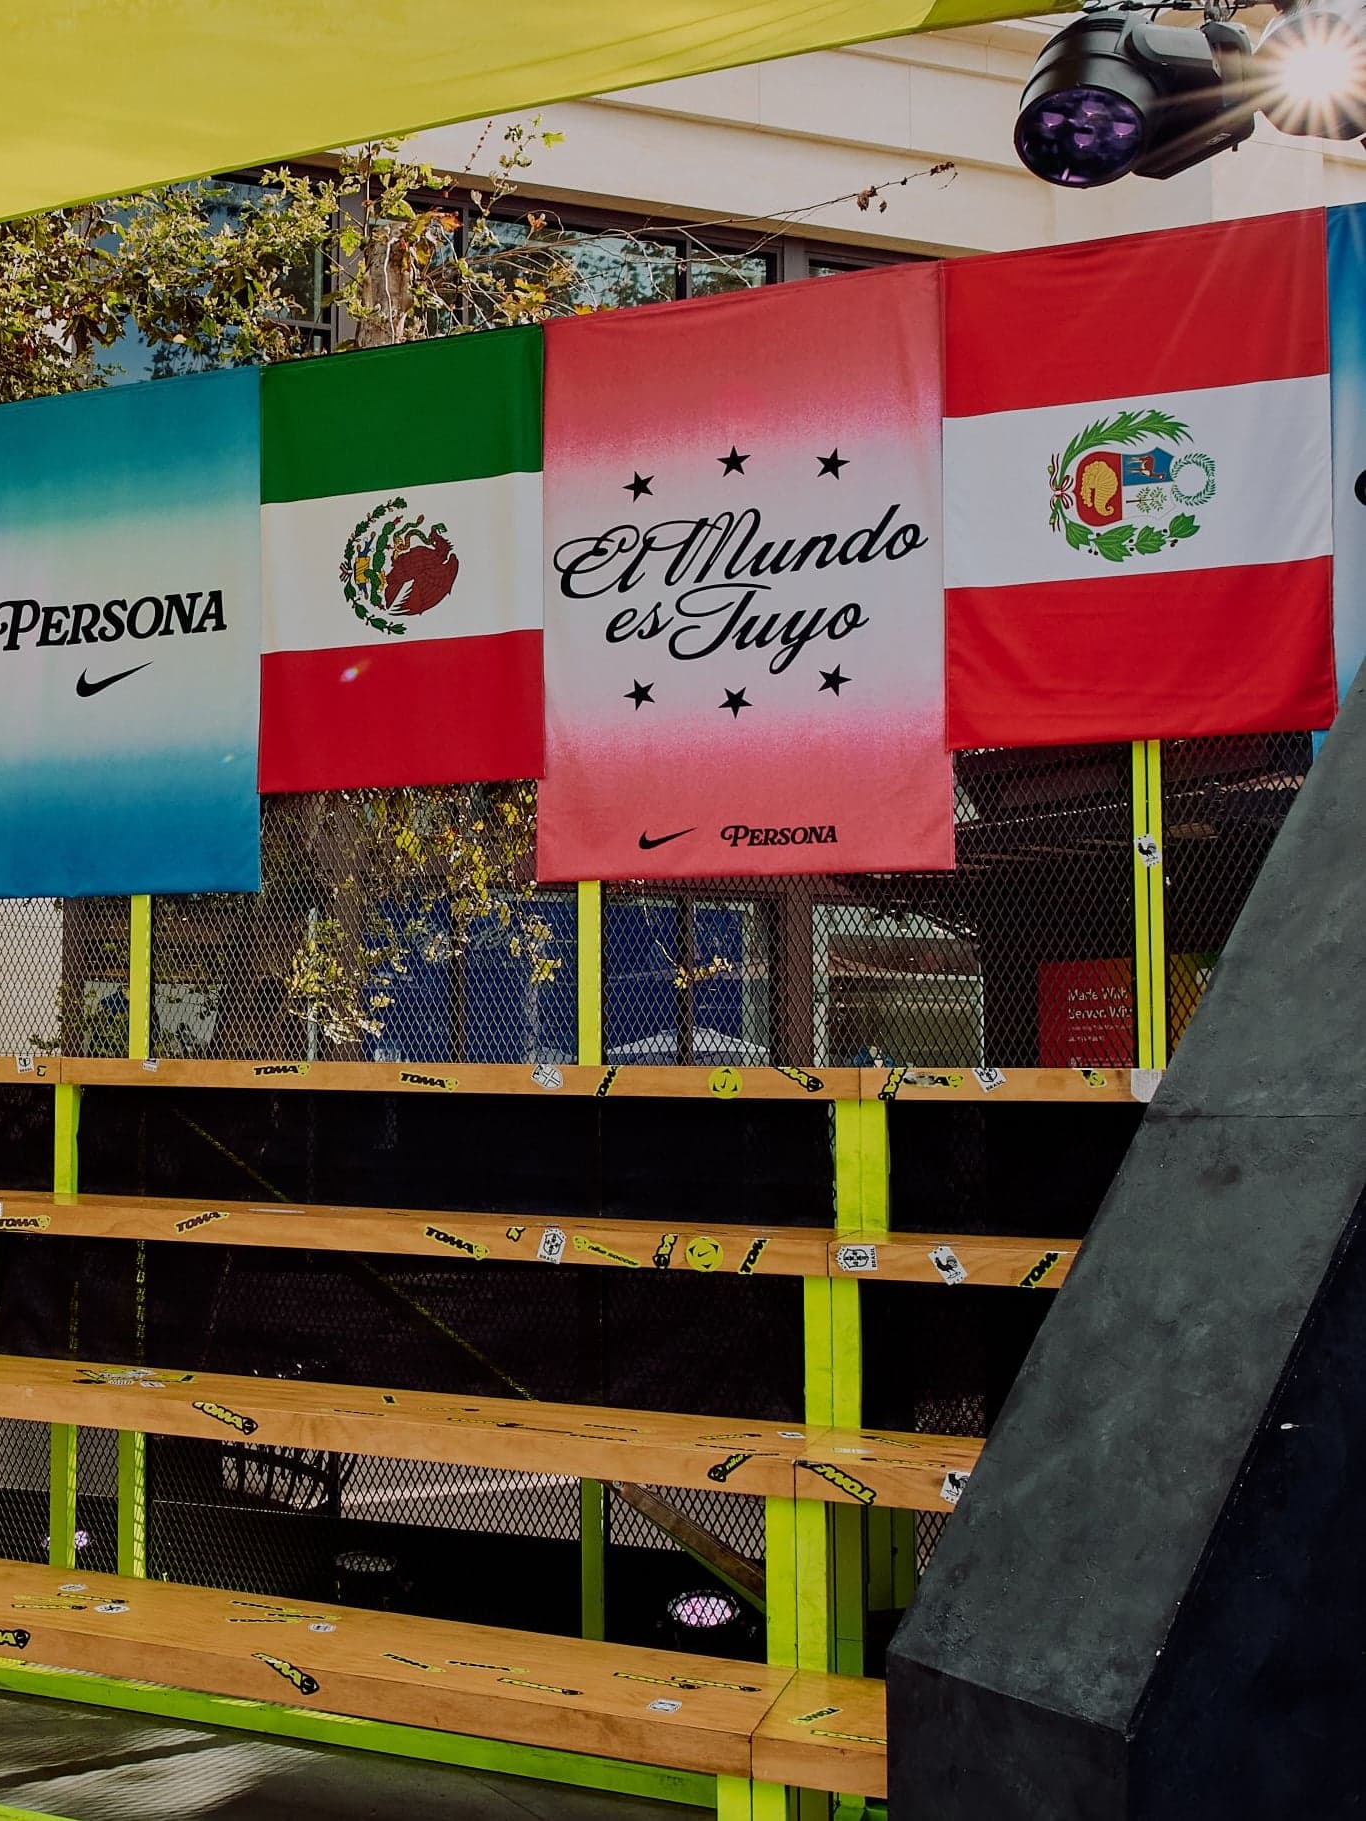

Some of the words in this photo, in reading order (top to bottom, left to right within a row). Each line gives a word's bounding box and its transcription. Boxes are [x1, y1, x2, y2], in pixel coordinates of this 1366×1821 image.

[554, 525, 646, 599] El
[643, 504, 929, 586] Mundo
[606, 602, 675, 644] es
[669, 583, 870, 675] Tuyo
[721, 826, 838, 847] PERSONA
[254, 1065, 299, 1076] TOMA
[401, 1072, 446, 1089] TOMA
[176, 1211, 221, 1233] TOMA
[425, 1226, 475, 1255] TOMA
